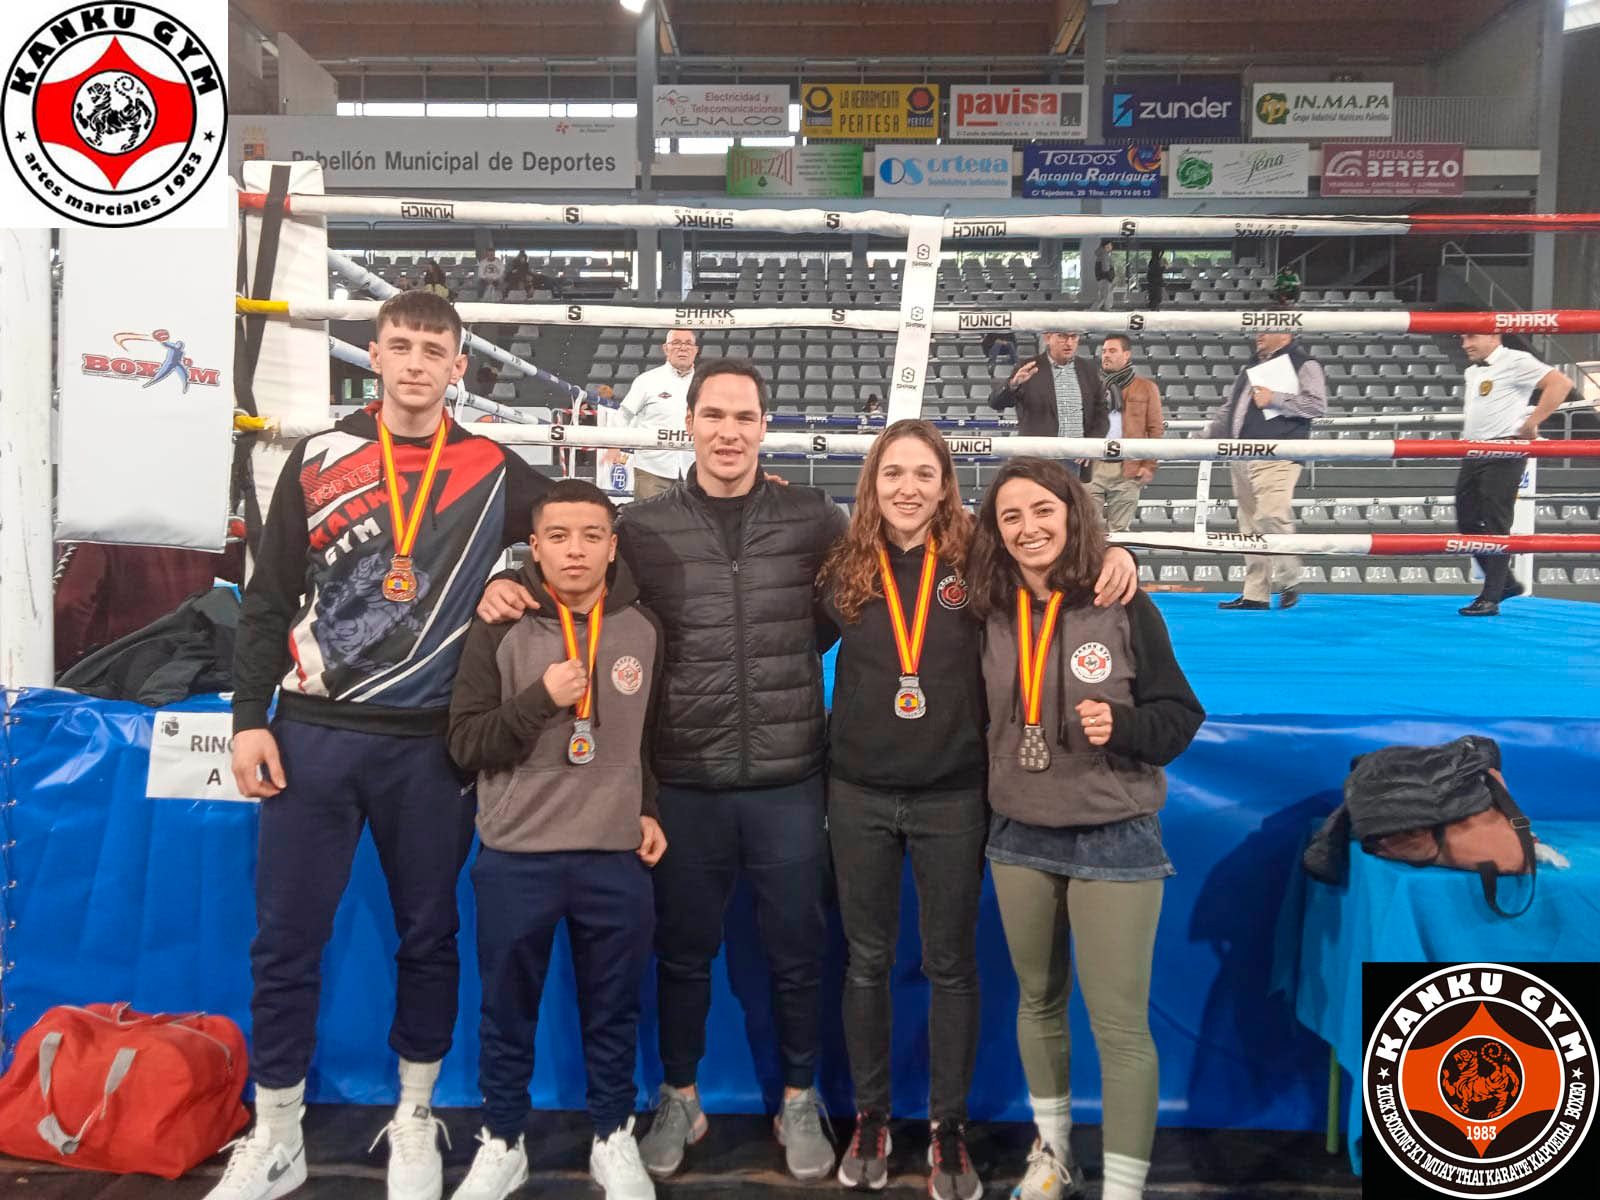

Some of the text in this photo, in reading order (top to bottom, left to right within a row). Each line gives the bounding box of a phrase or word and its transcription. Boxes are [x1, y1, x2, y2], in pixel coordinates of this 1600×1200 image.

[704, 91, 761, 102] Electricidad
[1294, 95, 1390, 109] IN.MA.PA
[690, 103, 785, 114] Telecomunicaciones
[957, 88, 1058, 127] pavisa
[1139, 96, 1232, 119] zunder
[661, 116, 782, 126] MENALCO
[840, 114, 900, 133] PERTESA
[385, 150, 479, 175] Municipal
[488, 150, 513, 172] de
[522, 151, 616, 175] Deportes
[1367, 160, 1460, 178] BEREZO
[1027, 168, 1082, 182] Antonio
[401, 203, 454, 220] MUNICH
[674, 214, 734, 229] SHARK
[953, 223, 1007, 239] MUNICH
[675, 308, 735, 319] SHARK
[959, 313, 1012, 329] MUNICH
[1241, 312, 1303, 327] SHARK
[1494, 313, 1559, 328] SHARK
[675, 318, 736, 326] BOXING
[657, 428, 696, 442] SHA
[948, 438, 991, 454] UNICH
[1217, 444, 1278, 456] SHARK
[324, 517, 382, 566] GYM
[1445, 539, 1510, 555] SHARK
[206, 768, 222, 786] A
